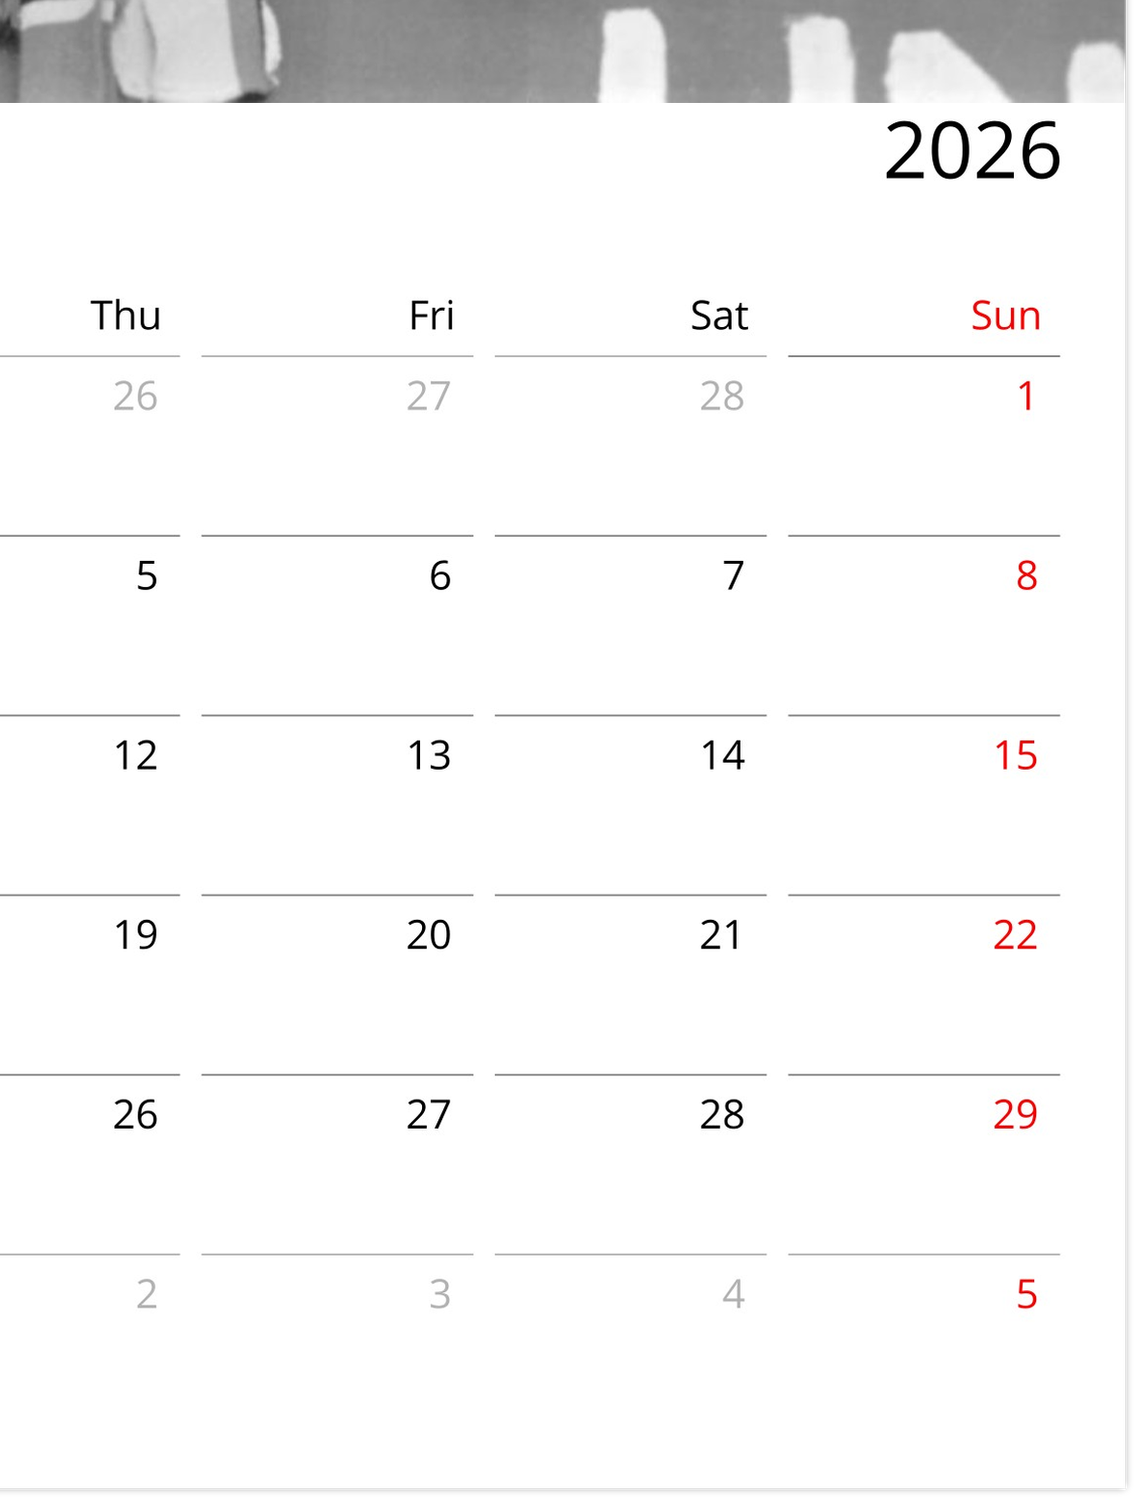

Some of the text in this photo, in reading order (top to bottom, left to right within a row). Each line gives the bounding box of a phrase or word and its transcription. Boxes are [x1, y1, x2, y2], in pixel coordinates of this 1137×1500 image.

[885, 119, 1061, 181] 2026
[89, 297, 160, 331] Thu
[411, 299, 454, 331] Fri
[691, 299, 749, 331] Sat
[971, 299, 1041, 331] Sun
[113, 380, 158, 411] 26
[407, 380, 451, 411] 27
[700, 380, 744, 411] 28
[1018, 380, 1032, 412] 1
[137, 559, 158, 591] 5
[430, 559, 451, 591] 6
[723, 559, 745, 591] 7
[1016, 559, 1038, 591] 8
[115, 739, 158, 771] 12
[409, 739, 451, 771] 13
[702, 739, 746, 771] 14
[995, 739, 1038, 771] 15
[115, 918, 158, 951] 19
[406, 918, 451, 951] 20
[700, 918, 738, 950] 21
[993, 918, 1038, 950] 22
[113, 1098, 158, 1130] 26
[406, 1098, 451, 1130] 27
[700, 1098, 745, 1130] 28
[993, 1098, 1038, 1130] 29
[137, 1278, 157, 1309] 2
[430, 1278, 450, 1309] 3
[722, 1278, 745, 1309] 4
[1017, 1278, 1038, 1310] 5
